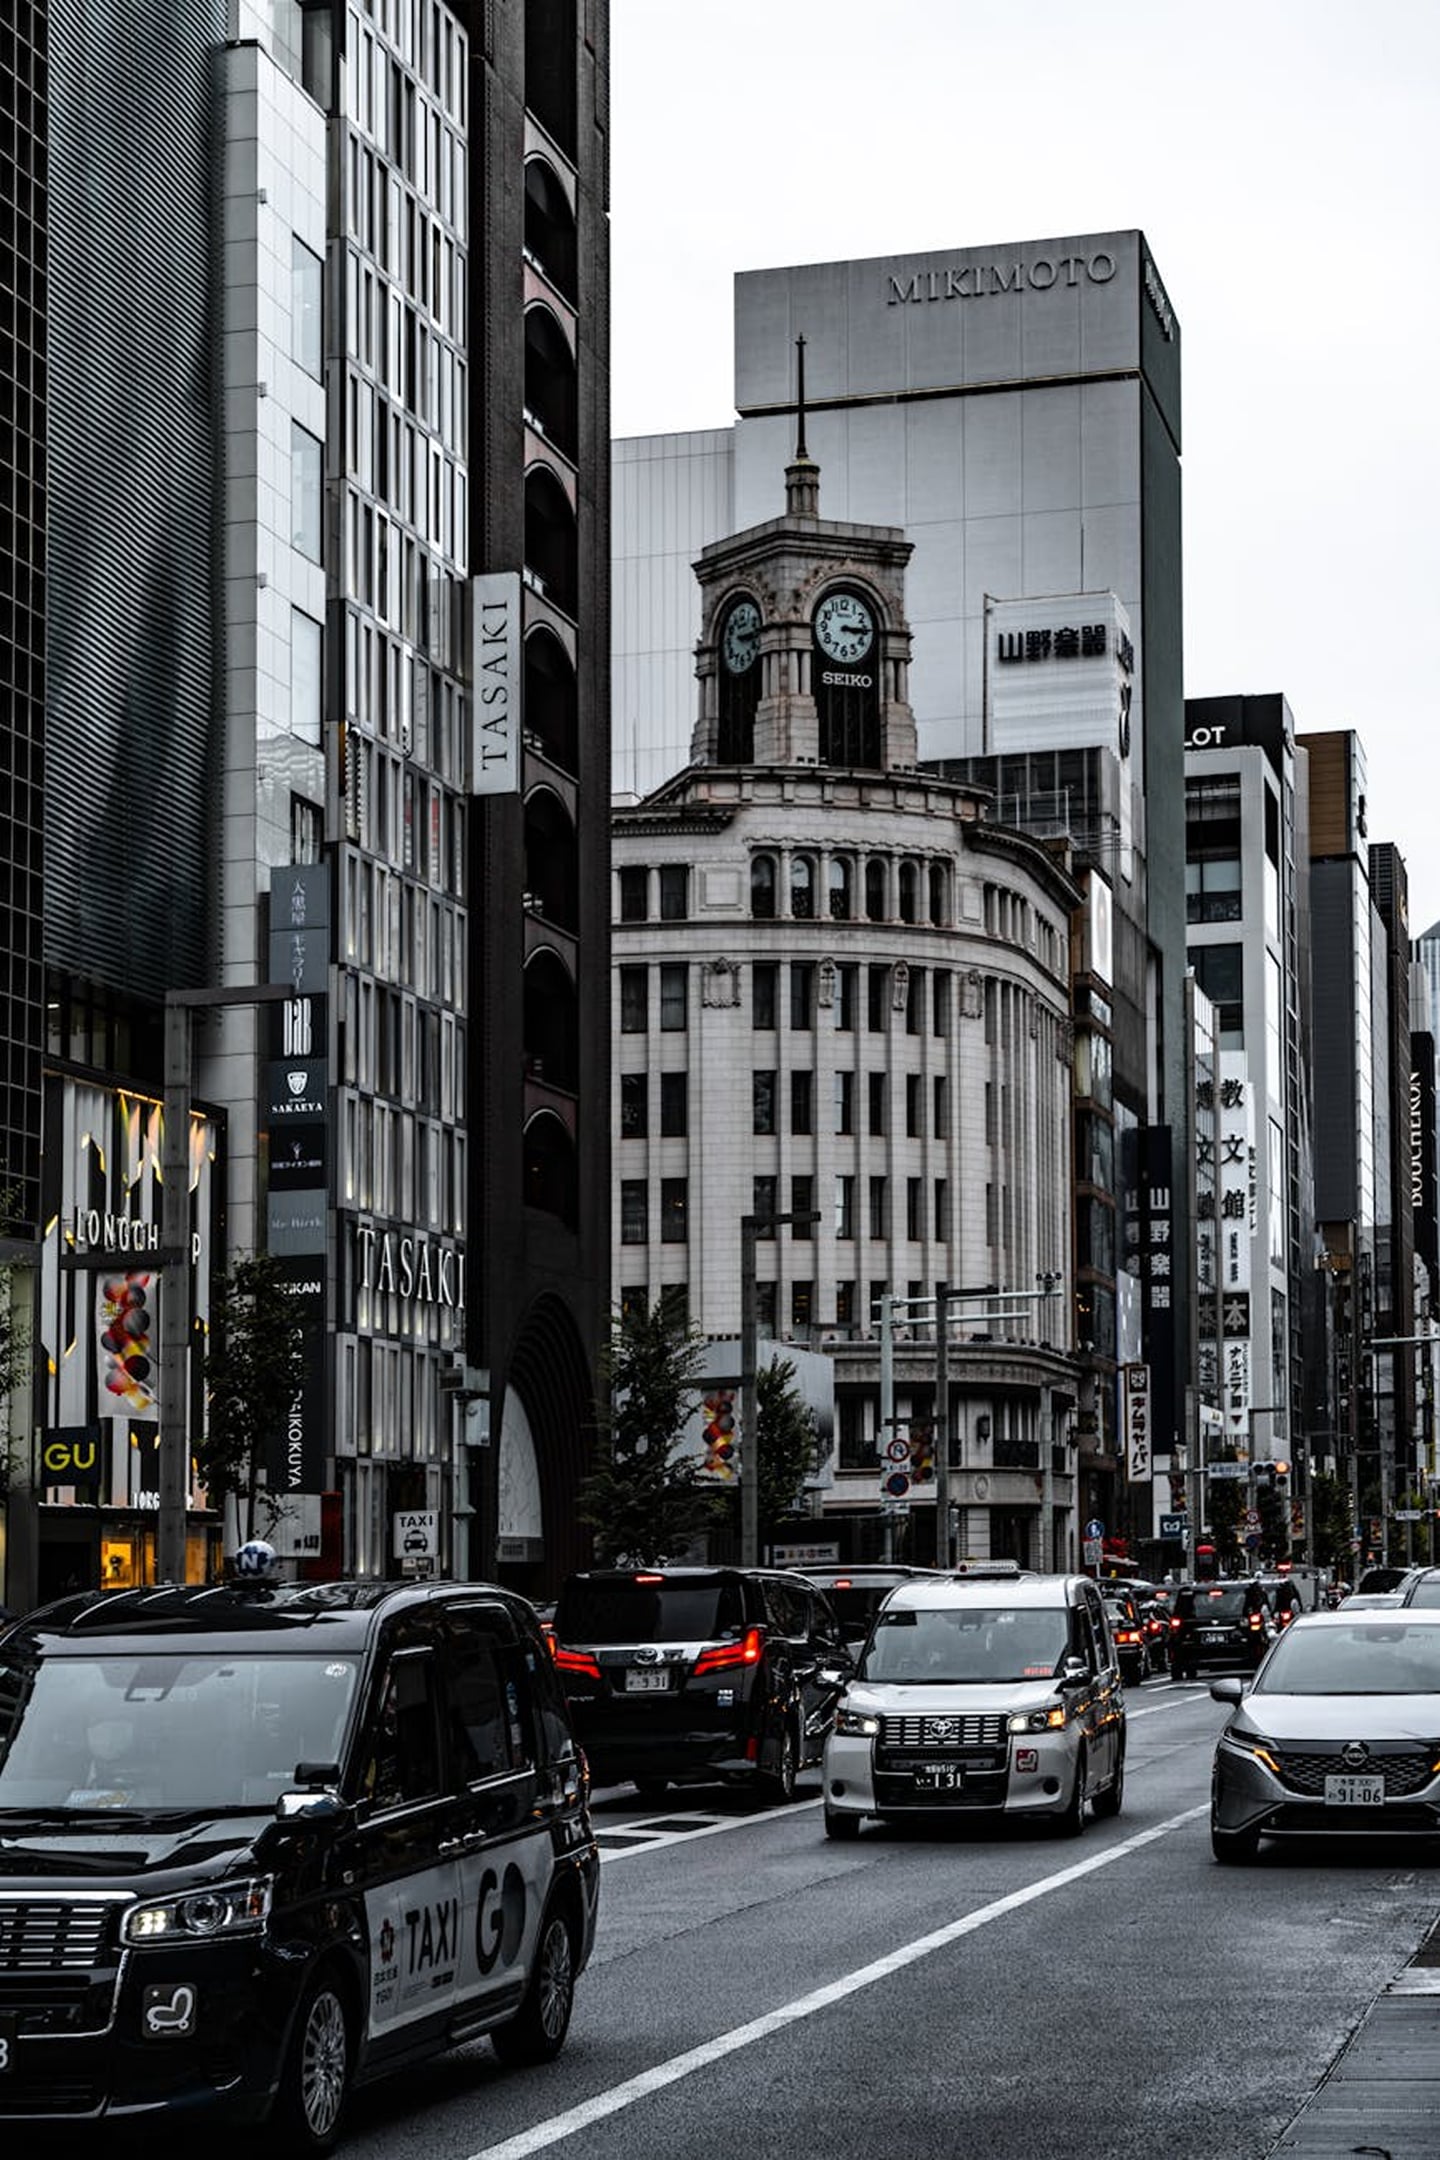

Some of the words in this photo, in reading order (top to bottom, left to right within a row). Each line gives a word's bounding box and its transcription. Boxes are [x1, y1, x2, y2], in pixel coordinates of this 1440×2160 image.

[888, 254, 1117, 305] MIKIMOTO
[482, 602, 508, 770] TASAKI
[822, 671, 872, 688] SEIKO
[1184, 727, 1226, 748] OT
[271, 1102, 323, 1114] SAKAEYA
[1221, 1079, 1245, 1220] 教文館
[1410, 1072, 1424, 1207] BOUCHERON
[357, 1228, 464, 1309] TASAKI
[1149, 1187, 1171, 1308] 山野楽器
[1223, 1299, 1247, 1331] 本
[43, 1442, 96, 1472] GU
[400, 1515, 433, 1528] TAXI
[405, 1898, 458, 1976] TAXI
[476, 1862, 526, 1976] GO
